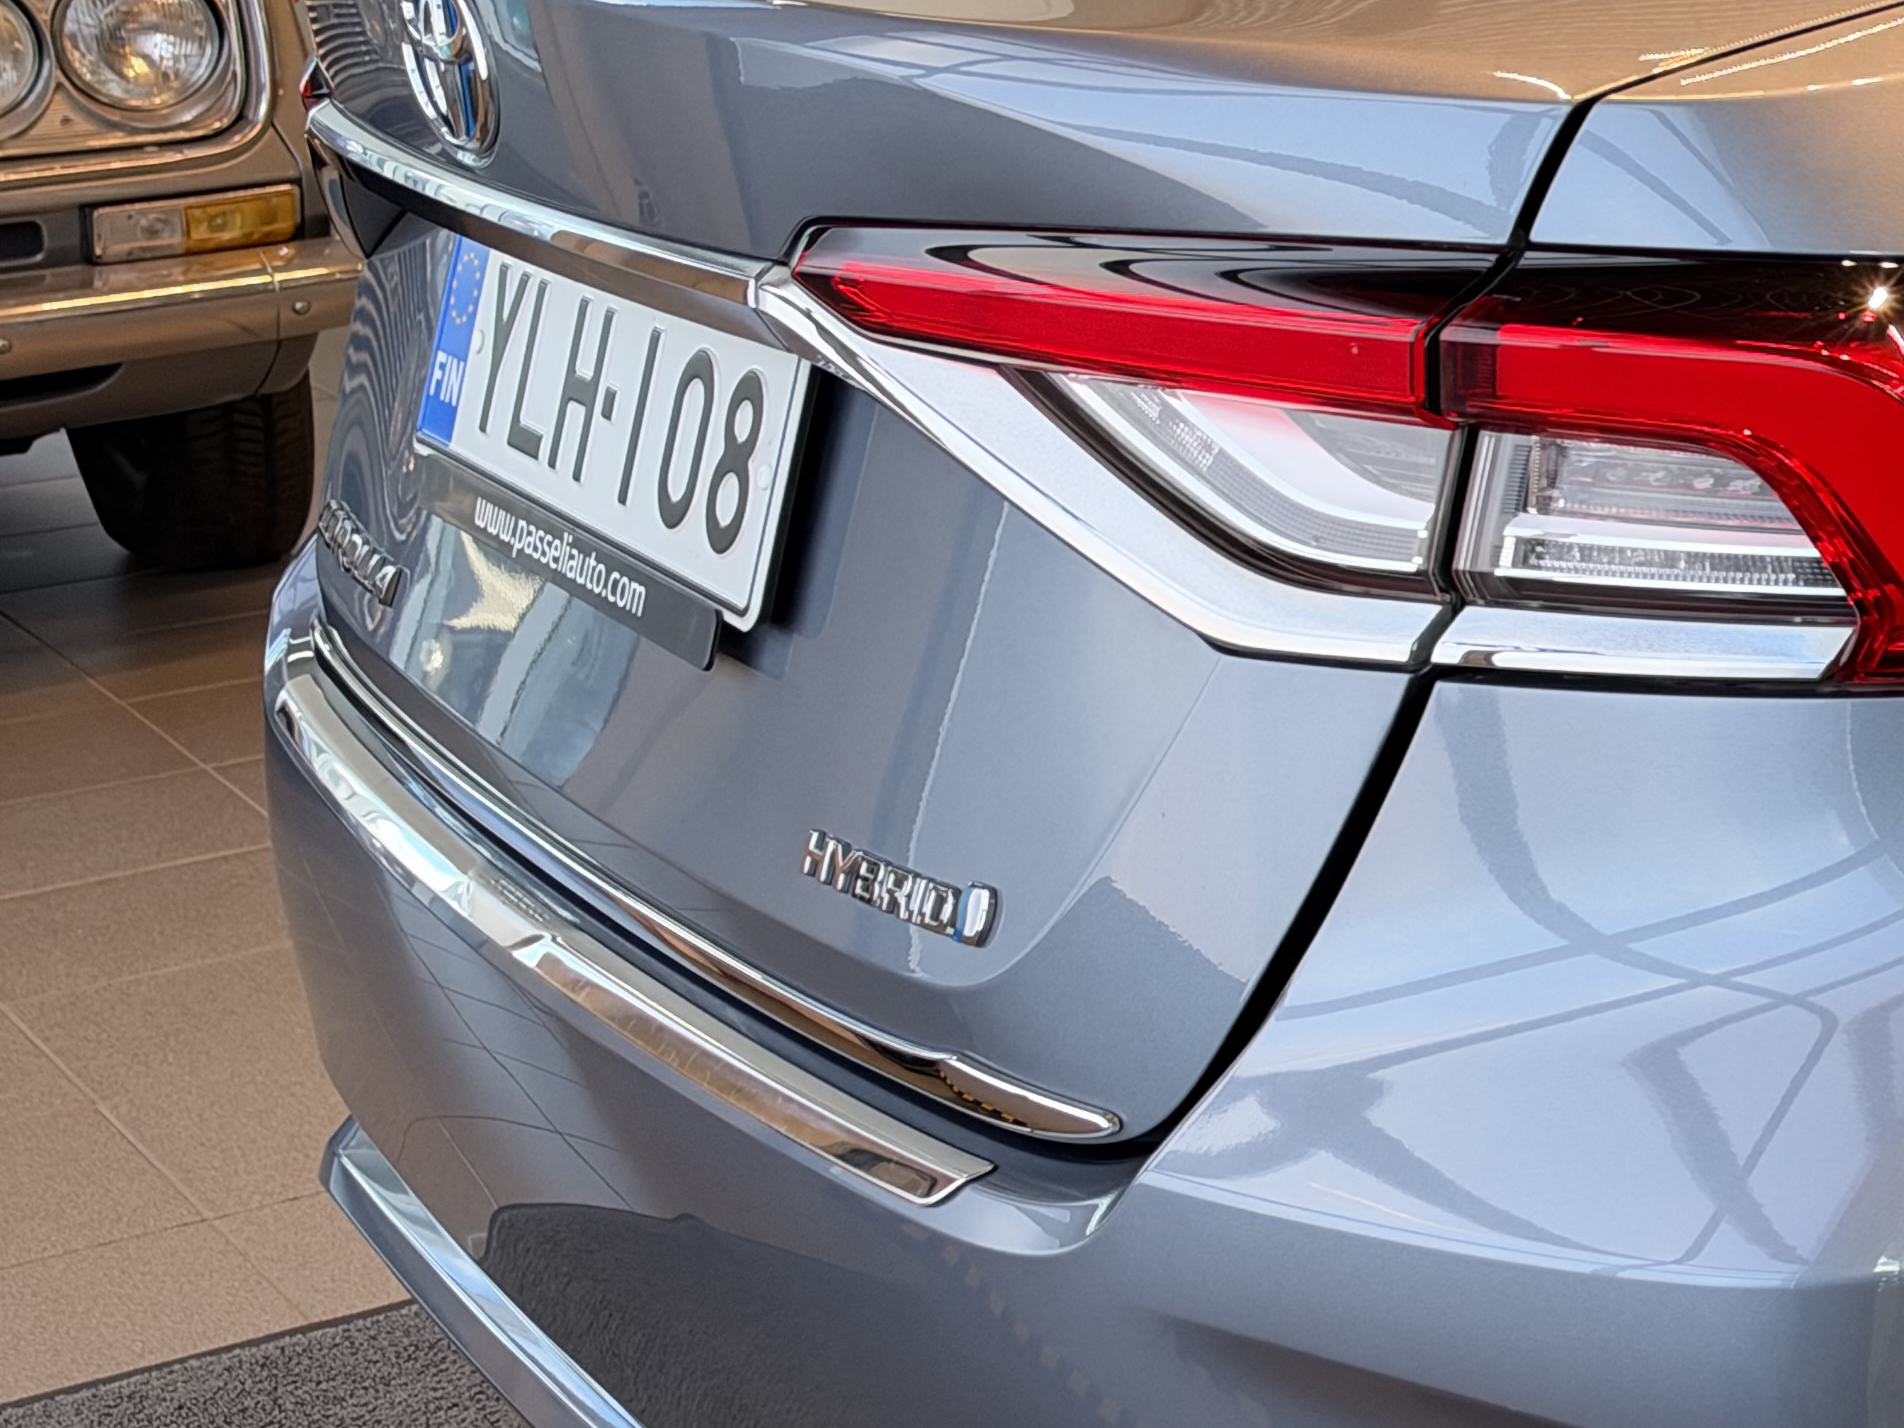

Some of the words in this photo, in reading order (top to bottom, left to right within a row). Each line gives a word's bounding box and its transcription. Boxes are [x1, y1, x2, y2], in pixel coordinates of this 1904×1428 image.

[428, 350, 465, 407] FIN
[477, 261, 766, 555] YLH-108
[473, 494, 647, 619] www.passeliauto.com
[801, 827, 960, 937] HYBRID
